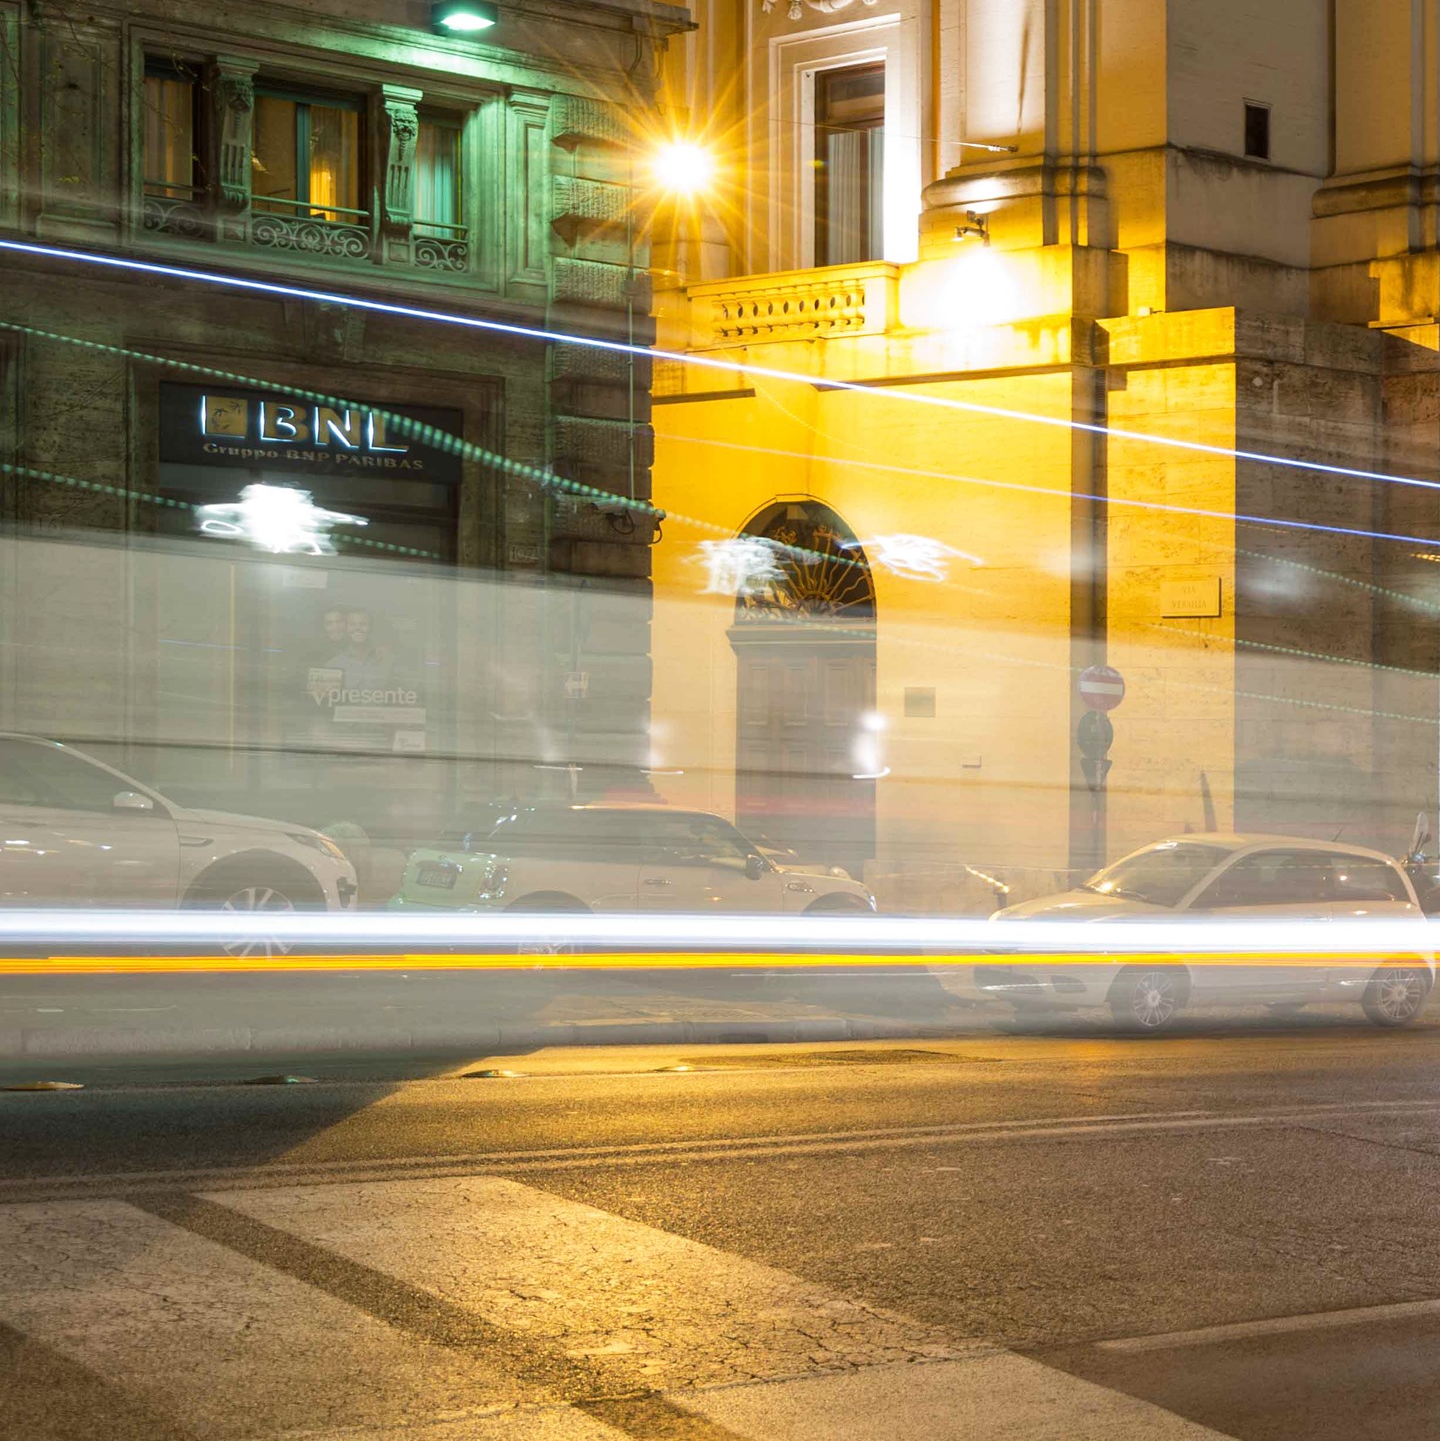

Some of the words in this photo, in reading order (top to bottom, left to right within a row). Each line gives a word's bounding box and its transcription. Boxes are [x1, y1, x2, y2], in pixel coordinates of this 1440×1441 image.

[259, 401, 409, 453] BNL
[202, 442, 279, 461] Gruppo
[286, 448, 331, 463] BNP
[335, 452, 425, 470] PARIBAS
[328, 687, 418, 707] presente
